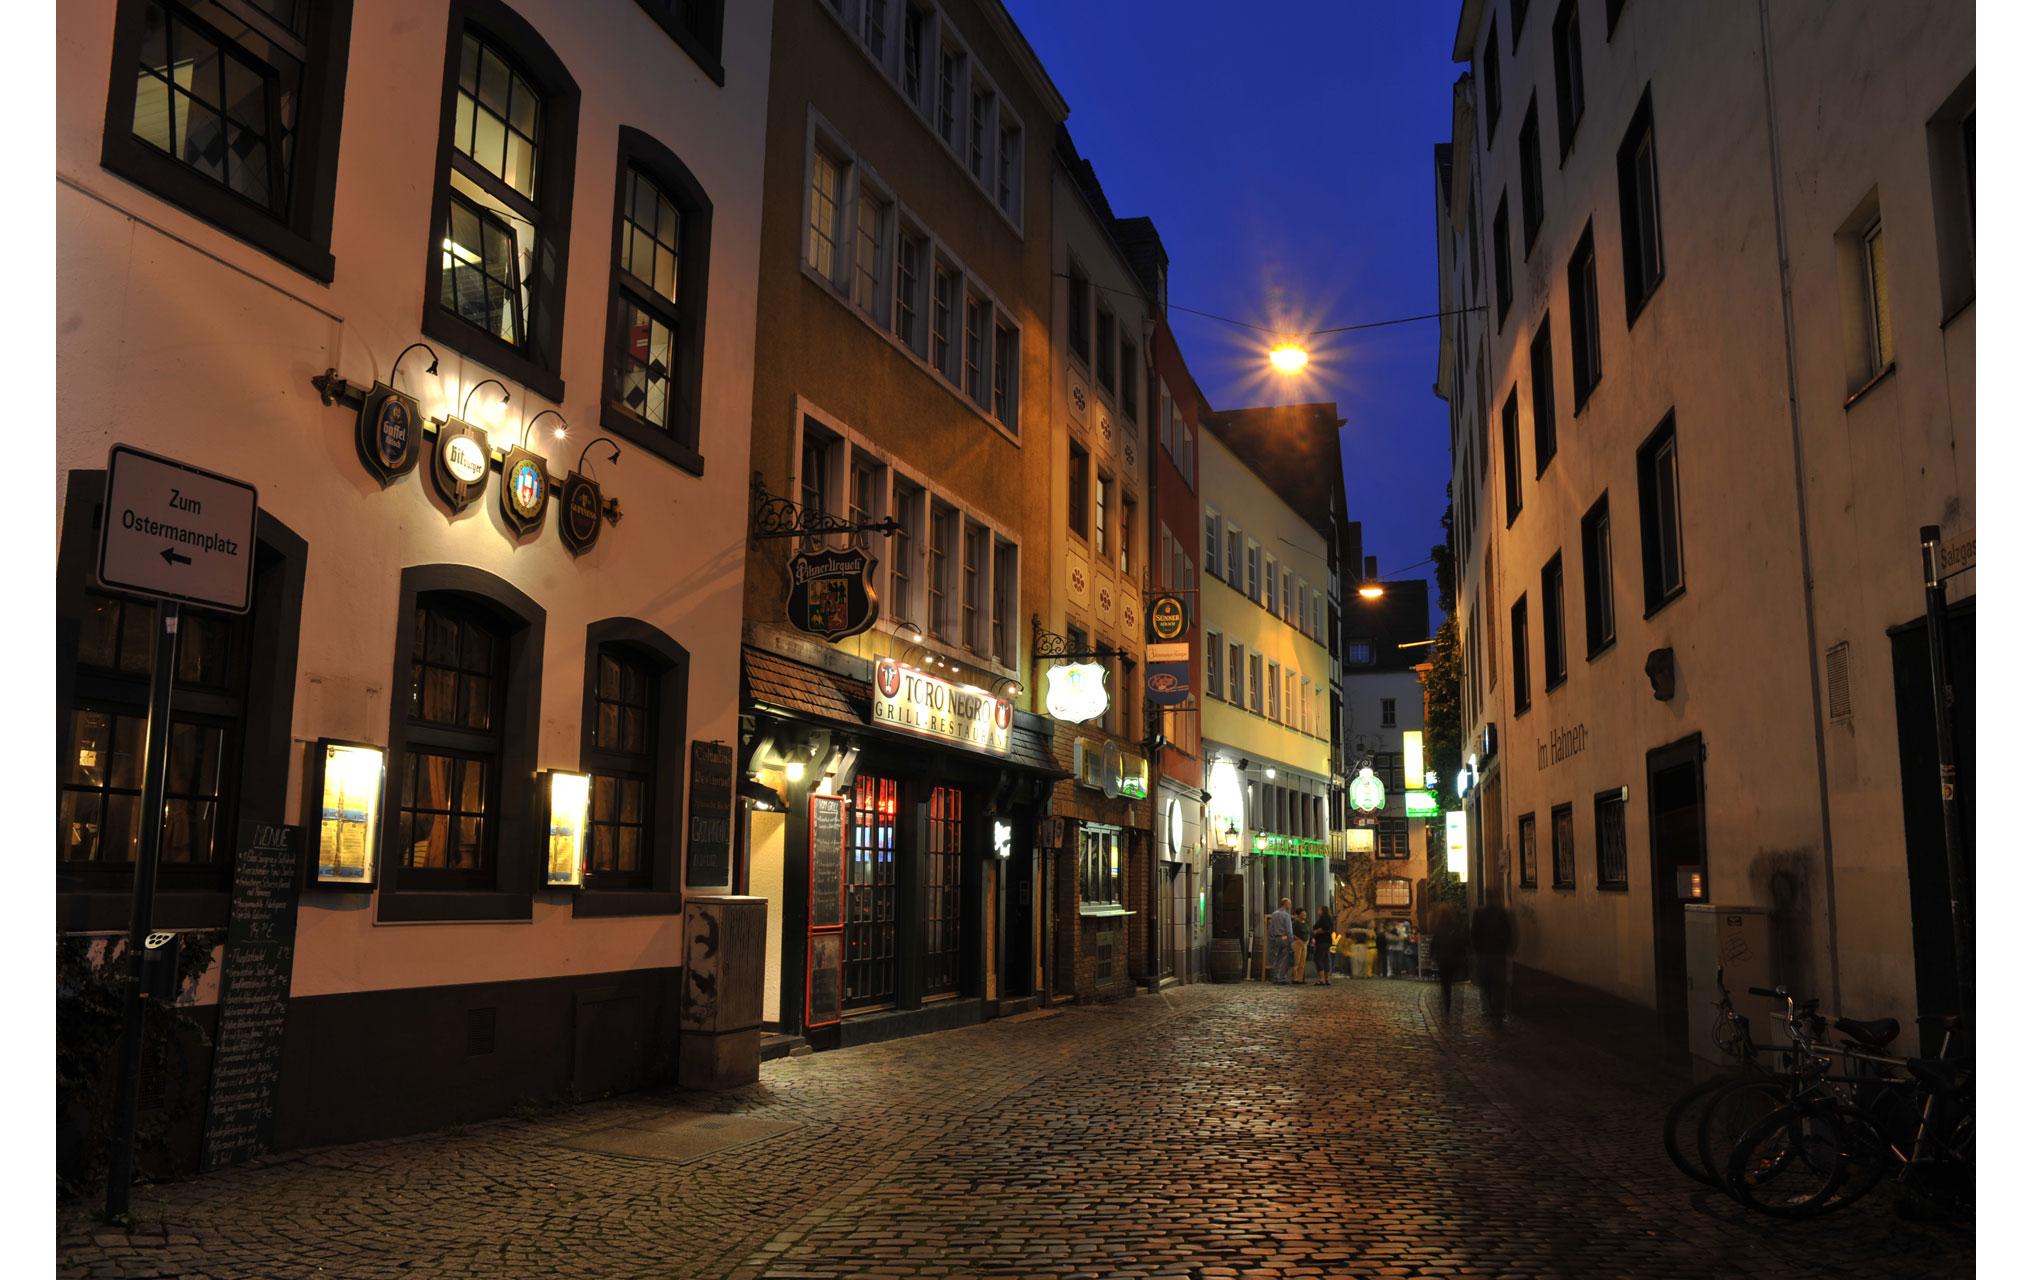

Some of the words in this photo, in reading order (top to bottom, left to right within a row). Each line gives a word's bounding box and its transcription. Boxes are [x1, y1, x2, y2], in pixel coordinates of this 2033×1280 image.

[169, 488, 201, 515] Zum
[122, 509, 238, 556] Ostermannplatz
[796, 557, 829, 586] Pilsner
[905, 675, 945, 710] TORO
[948, 689, 991, 723] NEGRO
[1537, 737, 1548, 771] Im
